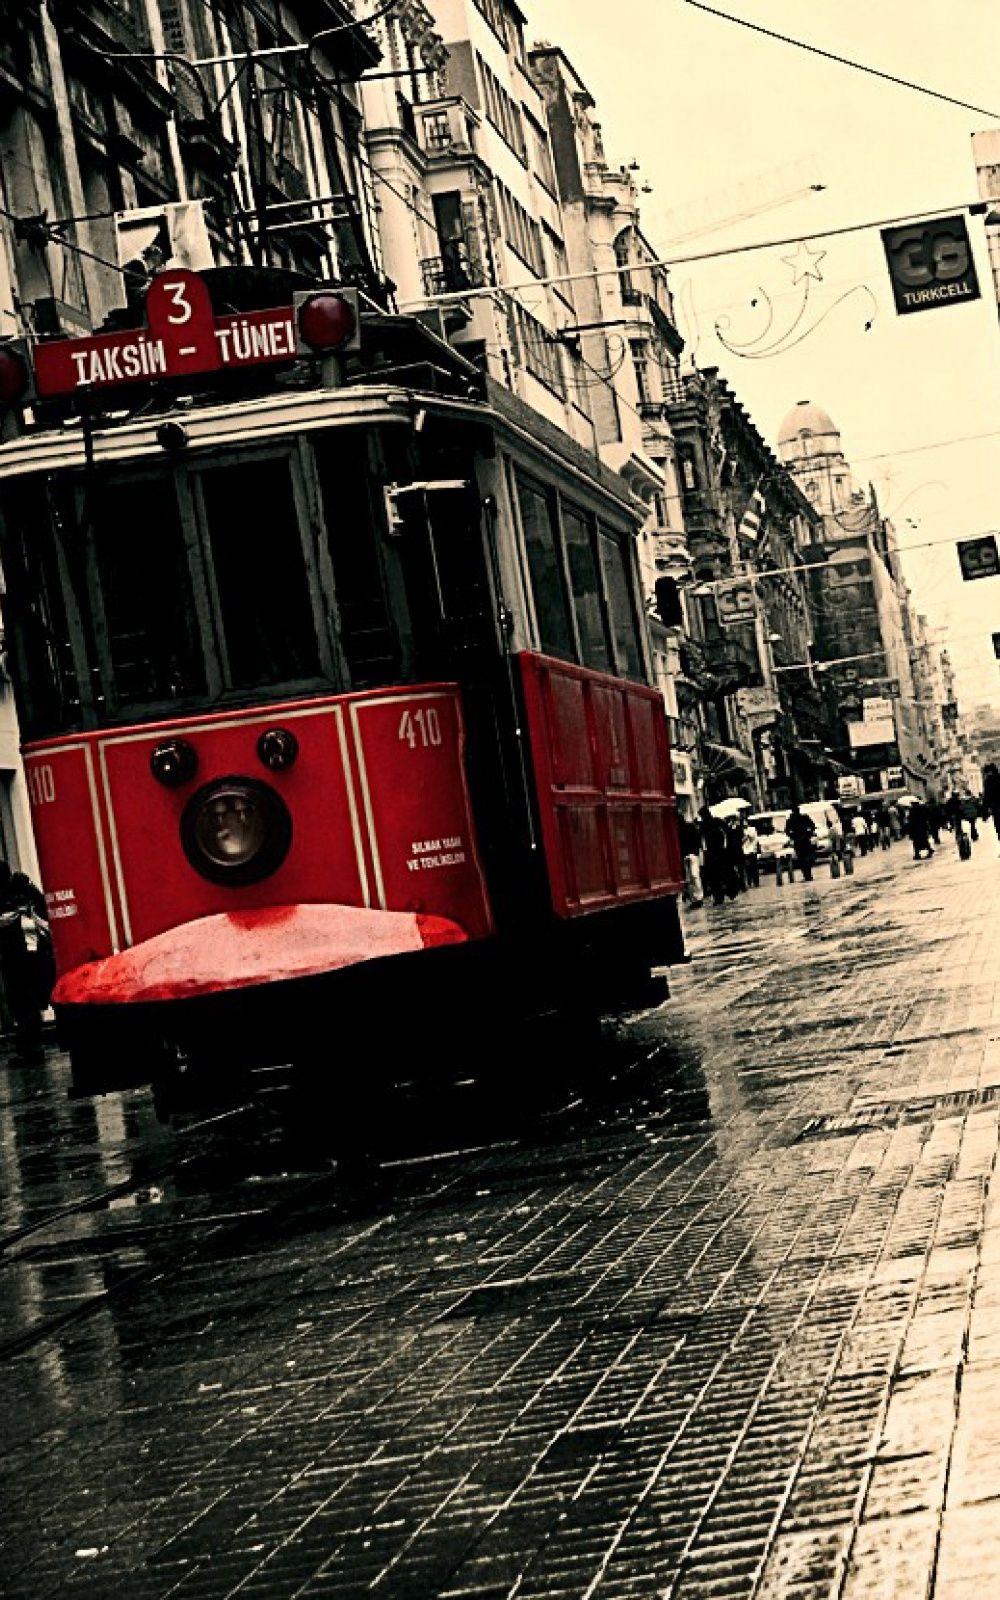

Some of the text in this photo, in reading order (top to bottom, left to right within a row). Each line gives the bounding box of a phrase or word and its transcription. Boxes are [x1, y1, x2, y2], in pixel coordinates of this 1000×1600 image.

[163, 281, 192, 325] 3
[903, 281, 972, 306] TURKCELL
[71, 336, 167, 386] TAKSİM
[398, 708, 442, 749] 410
